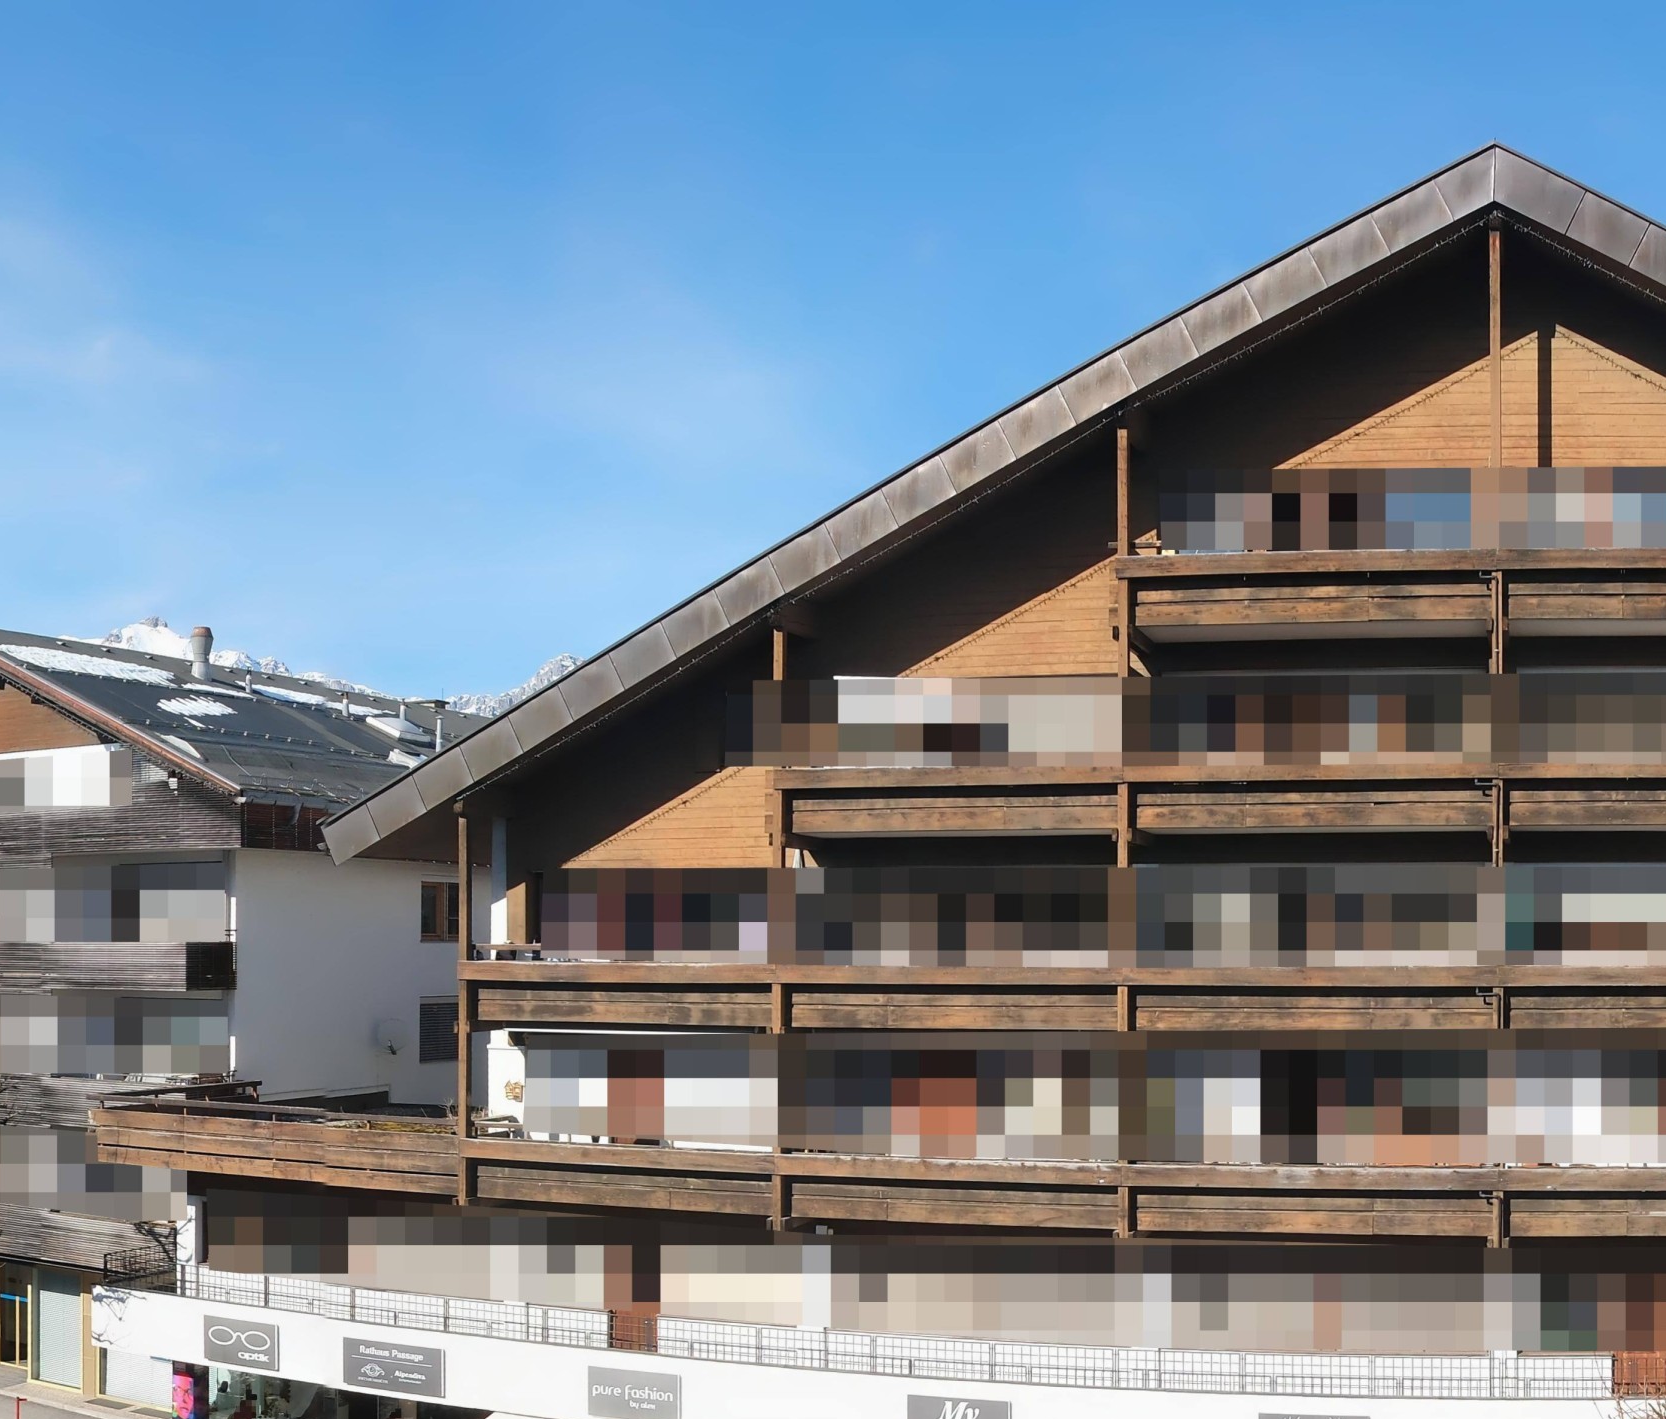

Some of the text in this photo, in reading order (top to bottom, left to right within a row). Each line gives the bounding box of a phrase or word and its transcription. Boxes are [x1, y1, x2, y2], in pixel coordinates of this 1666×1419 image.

[238, 1350, 270, 1363] optik
[359, 1344, 424, 1362] Rathaus Passage
[592, 1384, 674, 1402] pure fashion
[629, 1399, 640, 1410] by
